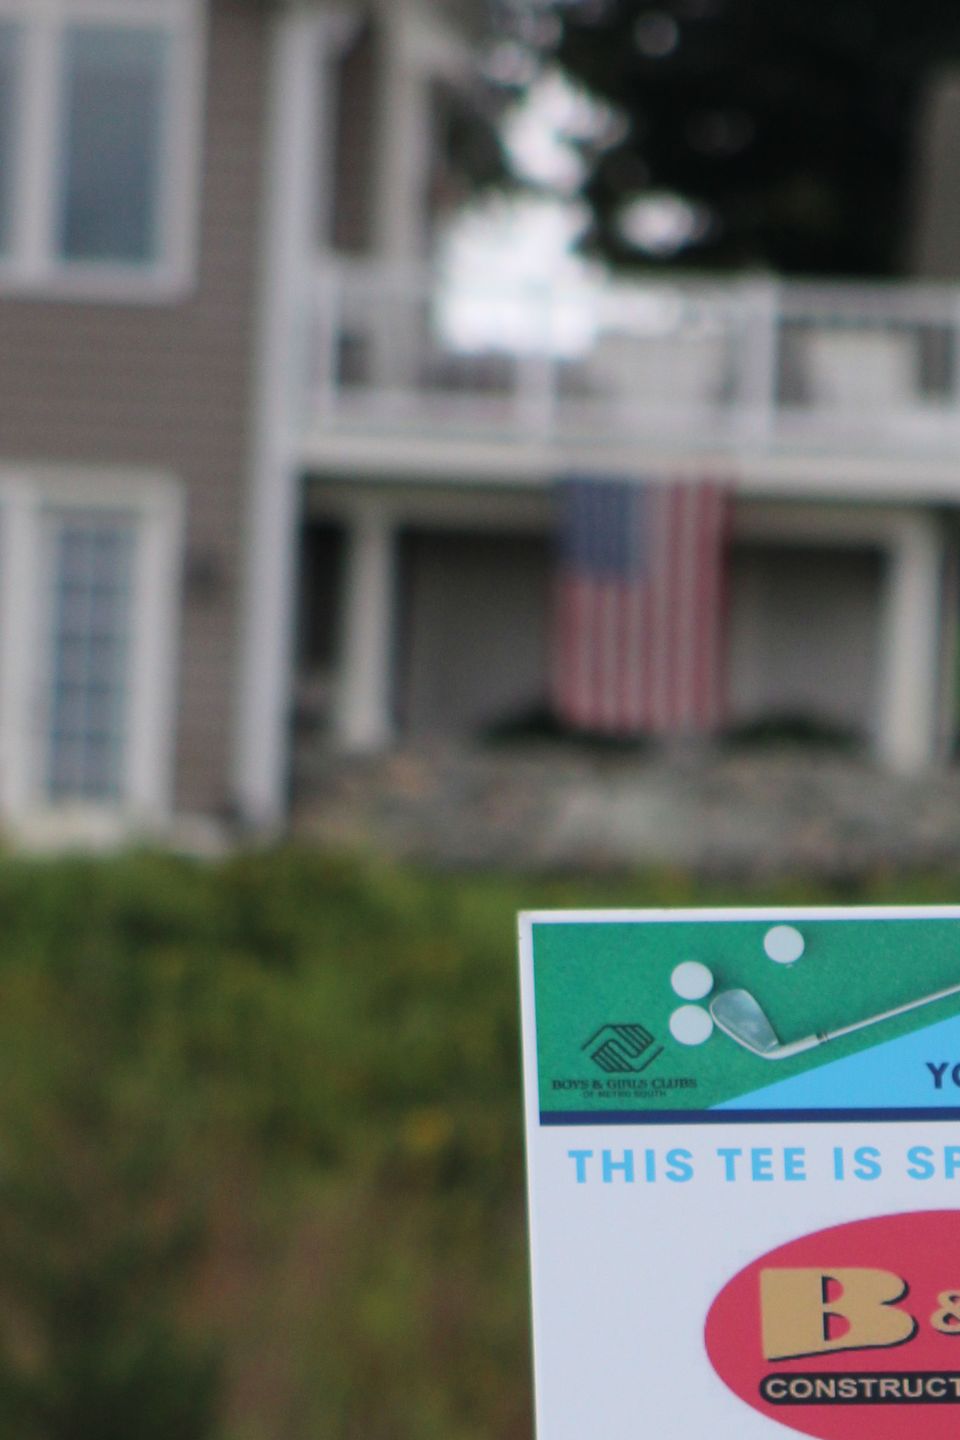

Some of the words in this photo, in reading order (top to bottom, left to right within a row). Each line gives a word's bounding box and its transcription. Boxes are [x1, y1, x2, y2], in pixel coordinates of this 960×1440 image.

[552, 1079, 589, 1090] BOYS
[592, 1079, 603, 1089] &
[607, 1078, 648, 1089] GIRLS
[652, 1077, 698, 1089] CLUBS
[568, 1148, 694, 1183] THIS
[716, 1148, 807, 1181] TEE
[834, 1146, 882, 1180] IS
[759, 1268, 919, 1362] B
